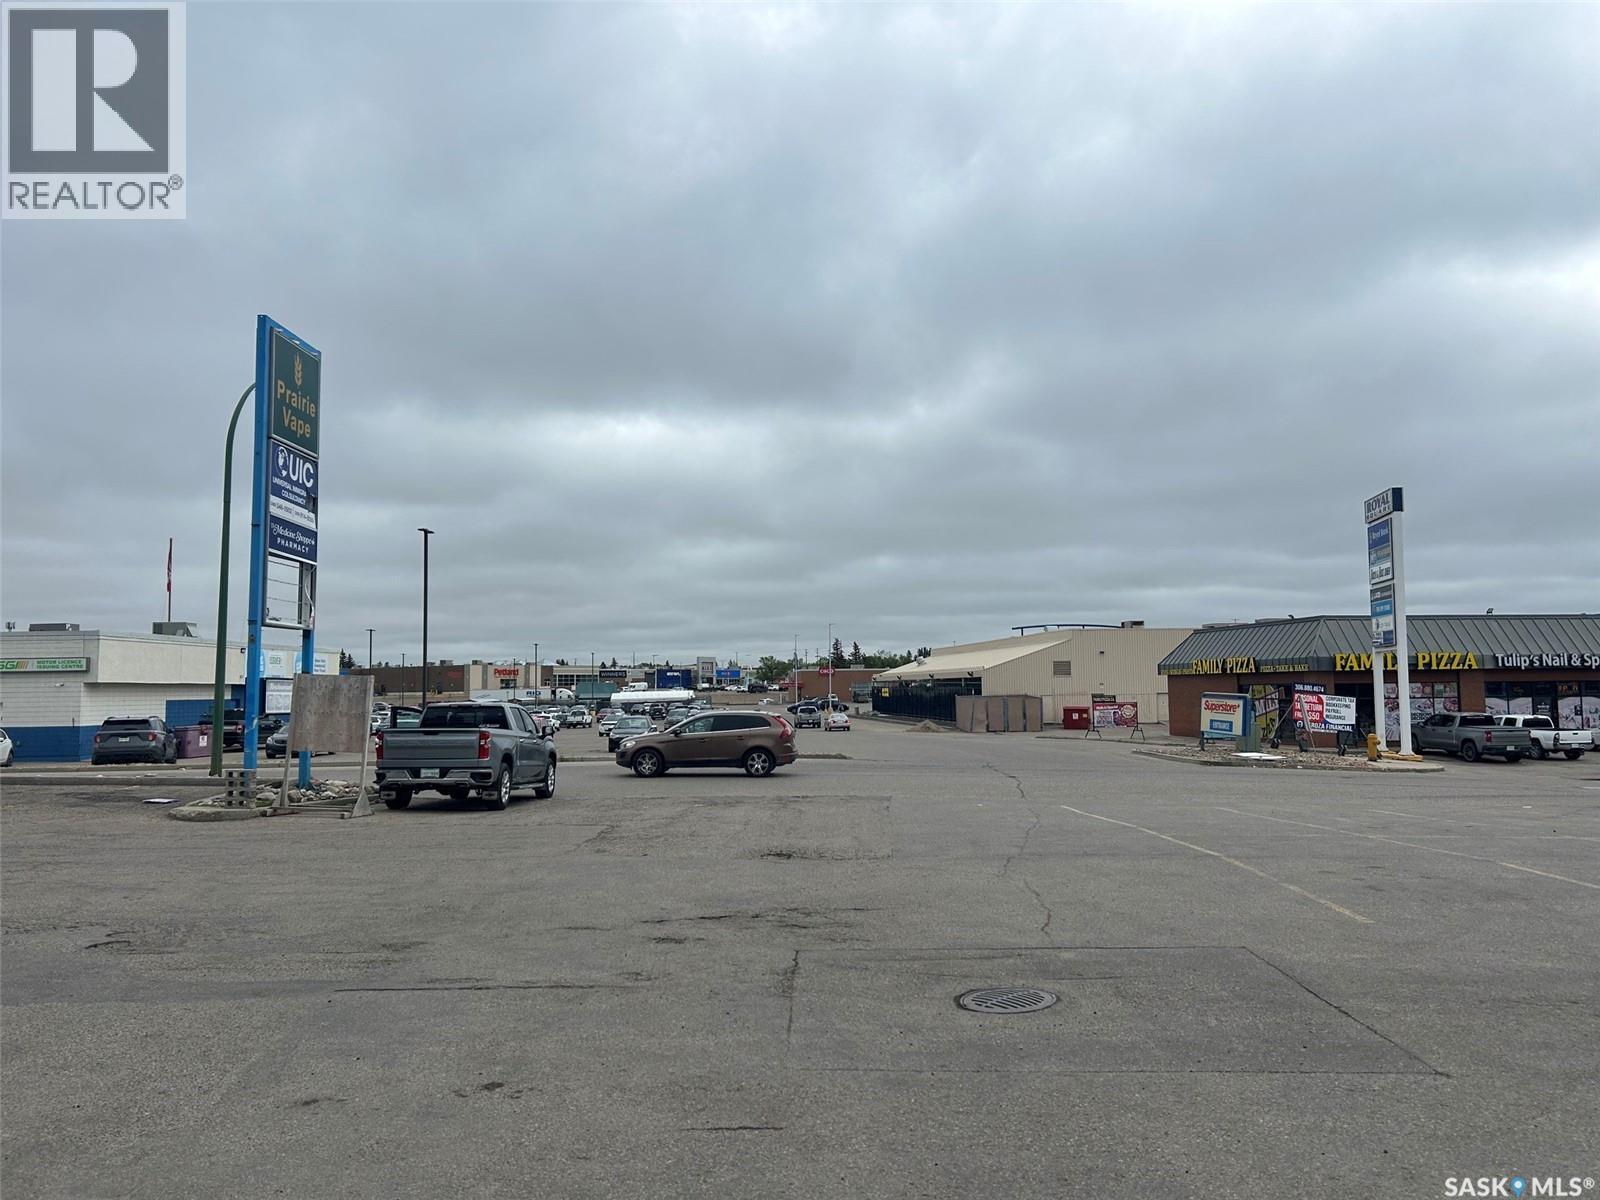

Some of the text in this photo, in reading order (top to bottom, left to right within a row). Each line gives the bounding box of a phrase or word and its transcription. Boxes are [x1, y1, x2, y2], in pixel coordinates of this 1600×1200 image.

[277, 380, 316, 417] Prairie
[282, 406, 311, 438] Vape
[289, 453, 314, 488] UIC
[1366, 493, 1390, 513] ROYAL
[273, 524, 296, 539] Medicine
[277, 537, 309, 553] PHARMACY
[1192, 656, 1256, 675] FAMILY PIZZA
[1335, 652, 1479, 671] FAML PIZZA
[1495, 653, 1540, 670] Tulip's
[1542, 653, 1569, 667] Nail
[1571, 653, 1582, 667] &
[494, 668, 519, 678] Petland
[1204, 699, 1237, 712] Superstore
[1326, 723, 1353, 732] FINANCIAL
